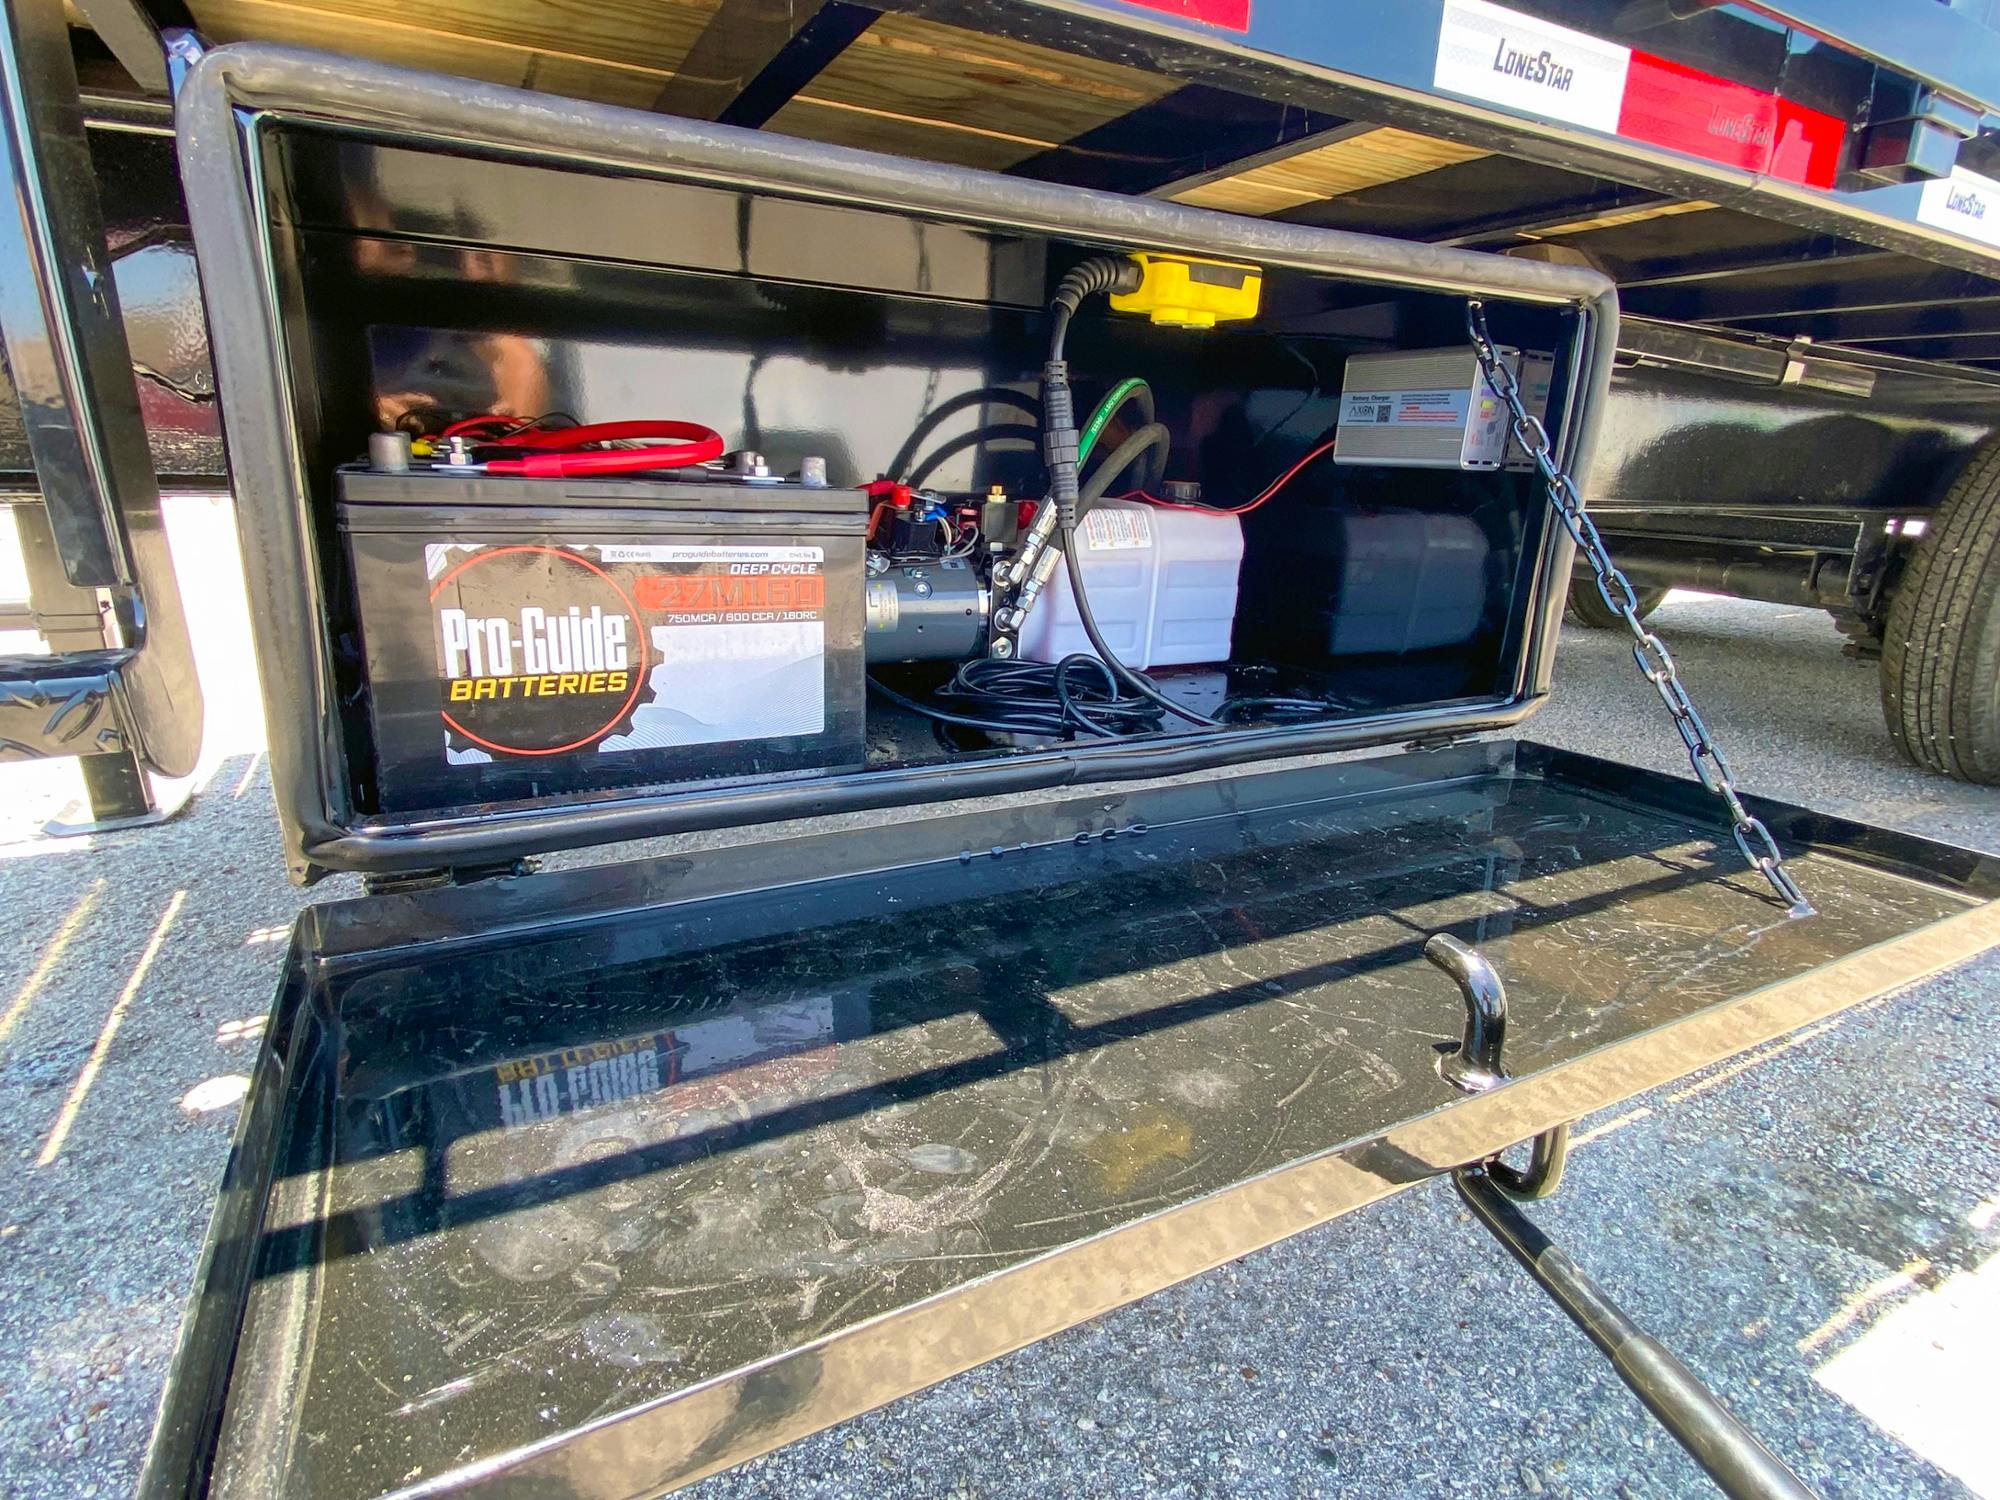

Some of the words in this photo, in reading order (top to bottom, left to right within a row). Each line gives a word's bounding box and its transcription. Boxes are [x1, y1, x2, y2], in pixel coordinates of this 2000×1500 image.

[672, 551, 769, 559] proguidebatteries.com
[730, 563, 769, 575] DEEP
[771, 562, 817, 575] CYCLE
[659, 578, 817, 608] 27M160
[441, 605, 628, 679] Pro-Guide
[450, 671, 629, 701] BATTERIES
